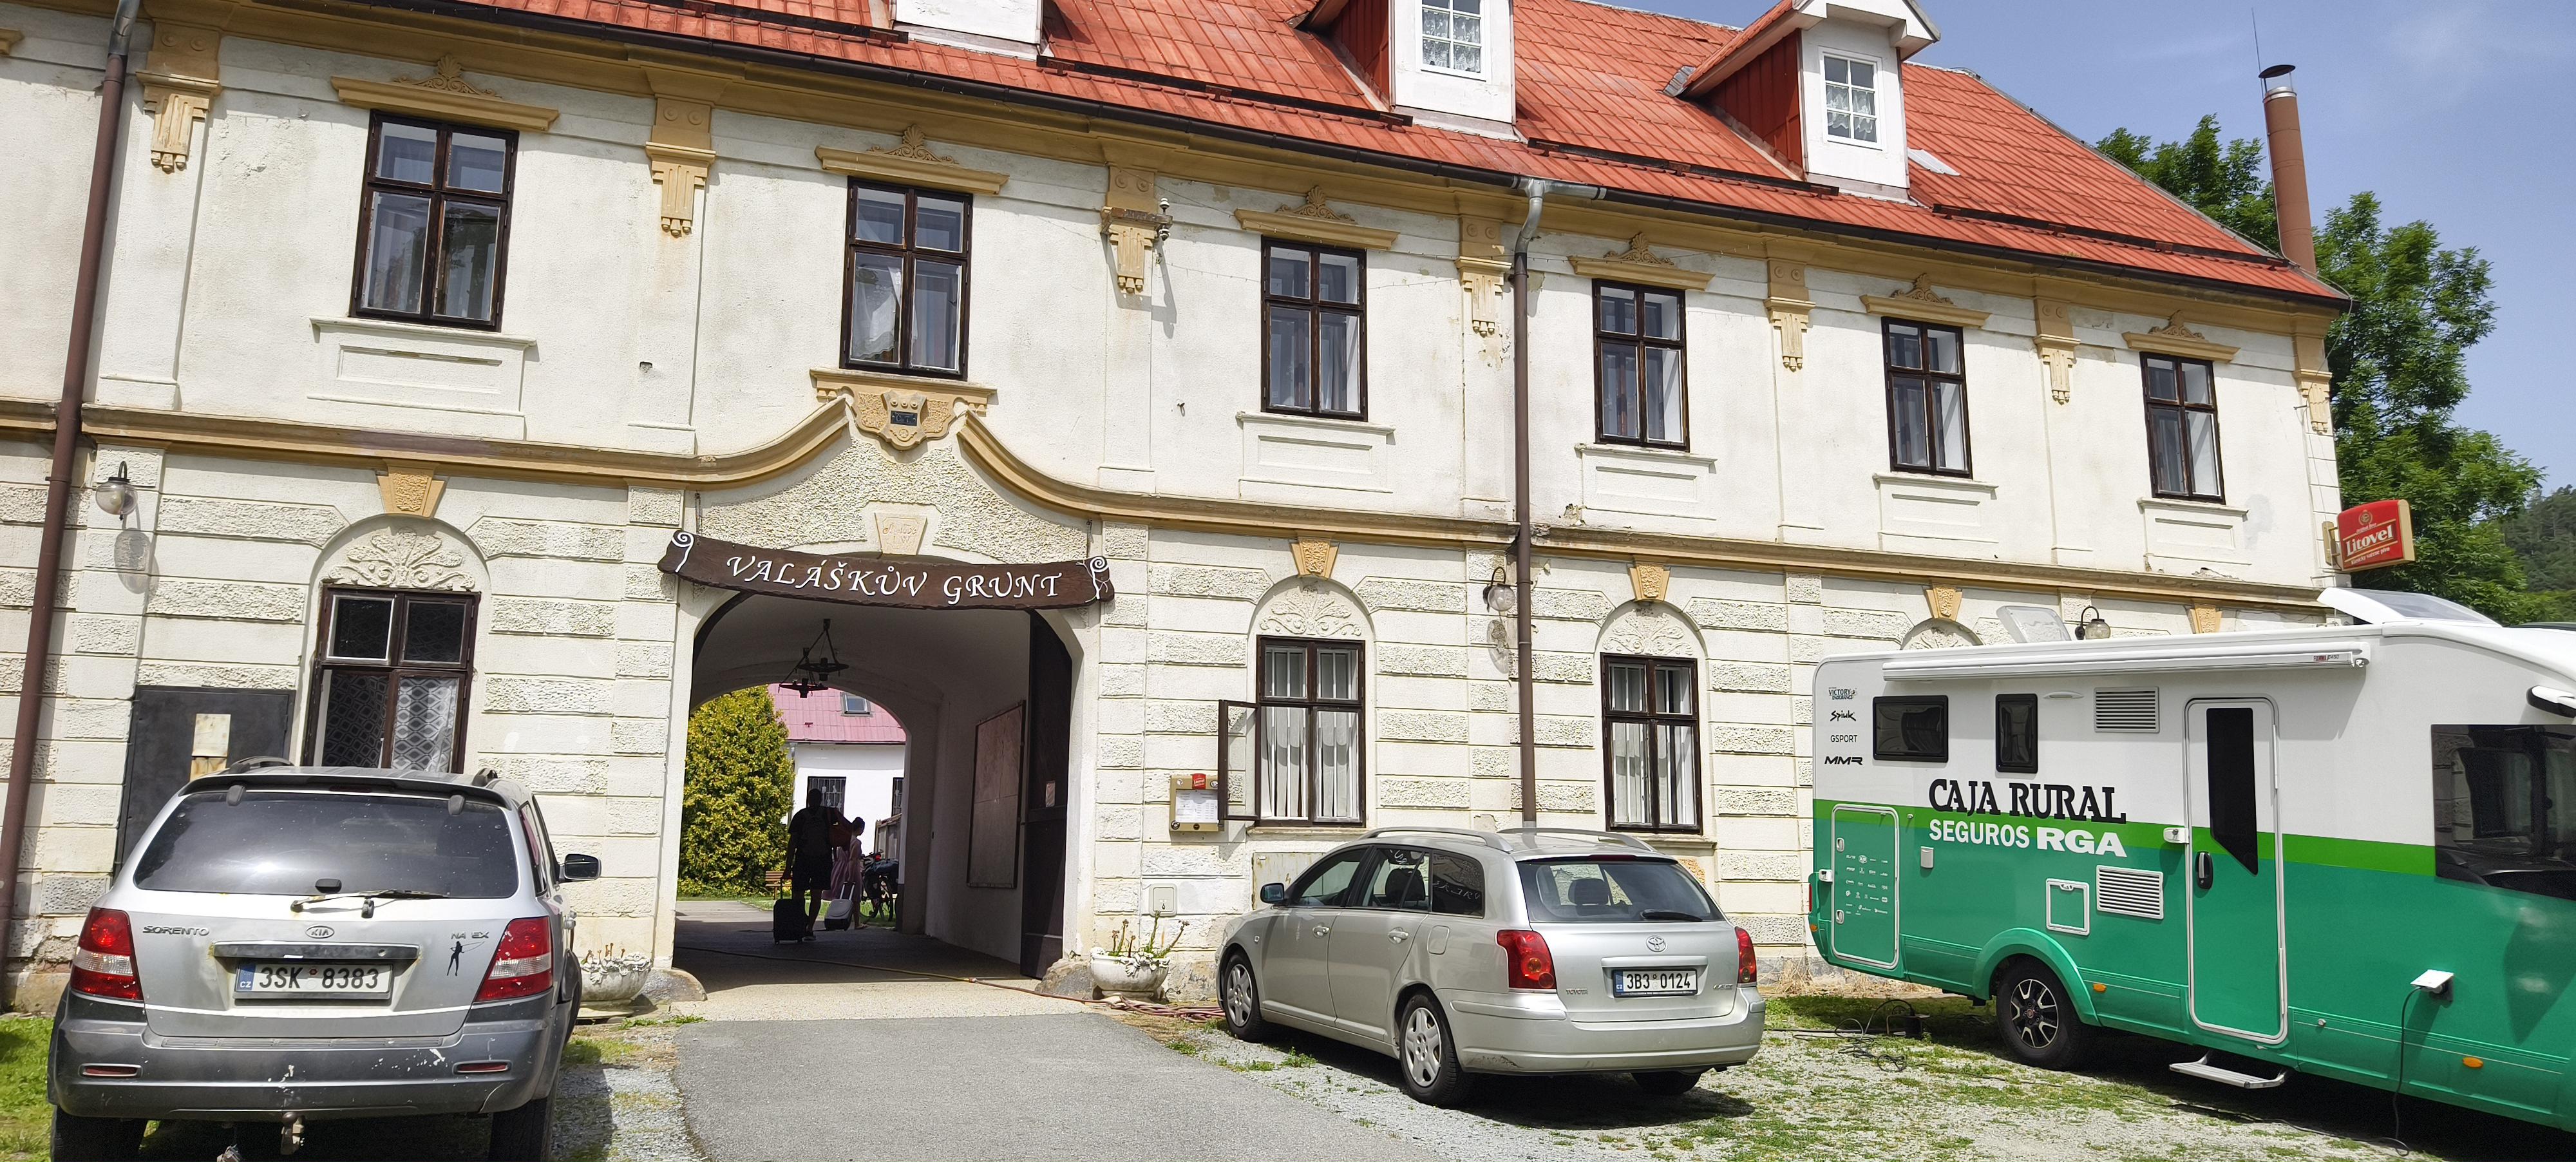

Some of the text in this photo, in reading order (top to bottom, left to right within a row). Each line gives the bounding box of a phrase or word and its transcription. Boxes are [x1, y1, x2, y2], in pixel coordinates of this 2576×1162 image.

[2346, 524, 2393, 557] Litovel
[726, 555, 1063, 605] VALÁŠKŮV GRUNT
[1830, 710, 1857, 721] Spiuk
[1830, 734, 1858, 743] GSPORT
[1824, 756, 1863, 766] MMR
[1929, 778, 2126, 824] CAJA RURAL
[1929, 819, 2127, 857] SEGUROS RGA
[142, 925, 210, 937] SORENTO
[310, 928, 329, 937] KIA
[450, 931, 489, 940] NA EX
[259, 966, 379, 989] 3SK 8383
[1626, 972, 1690, 989] 3B3 0124
